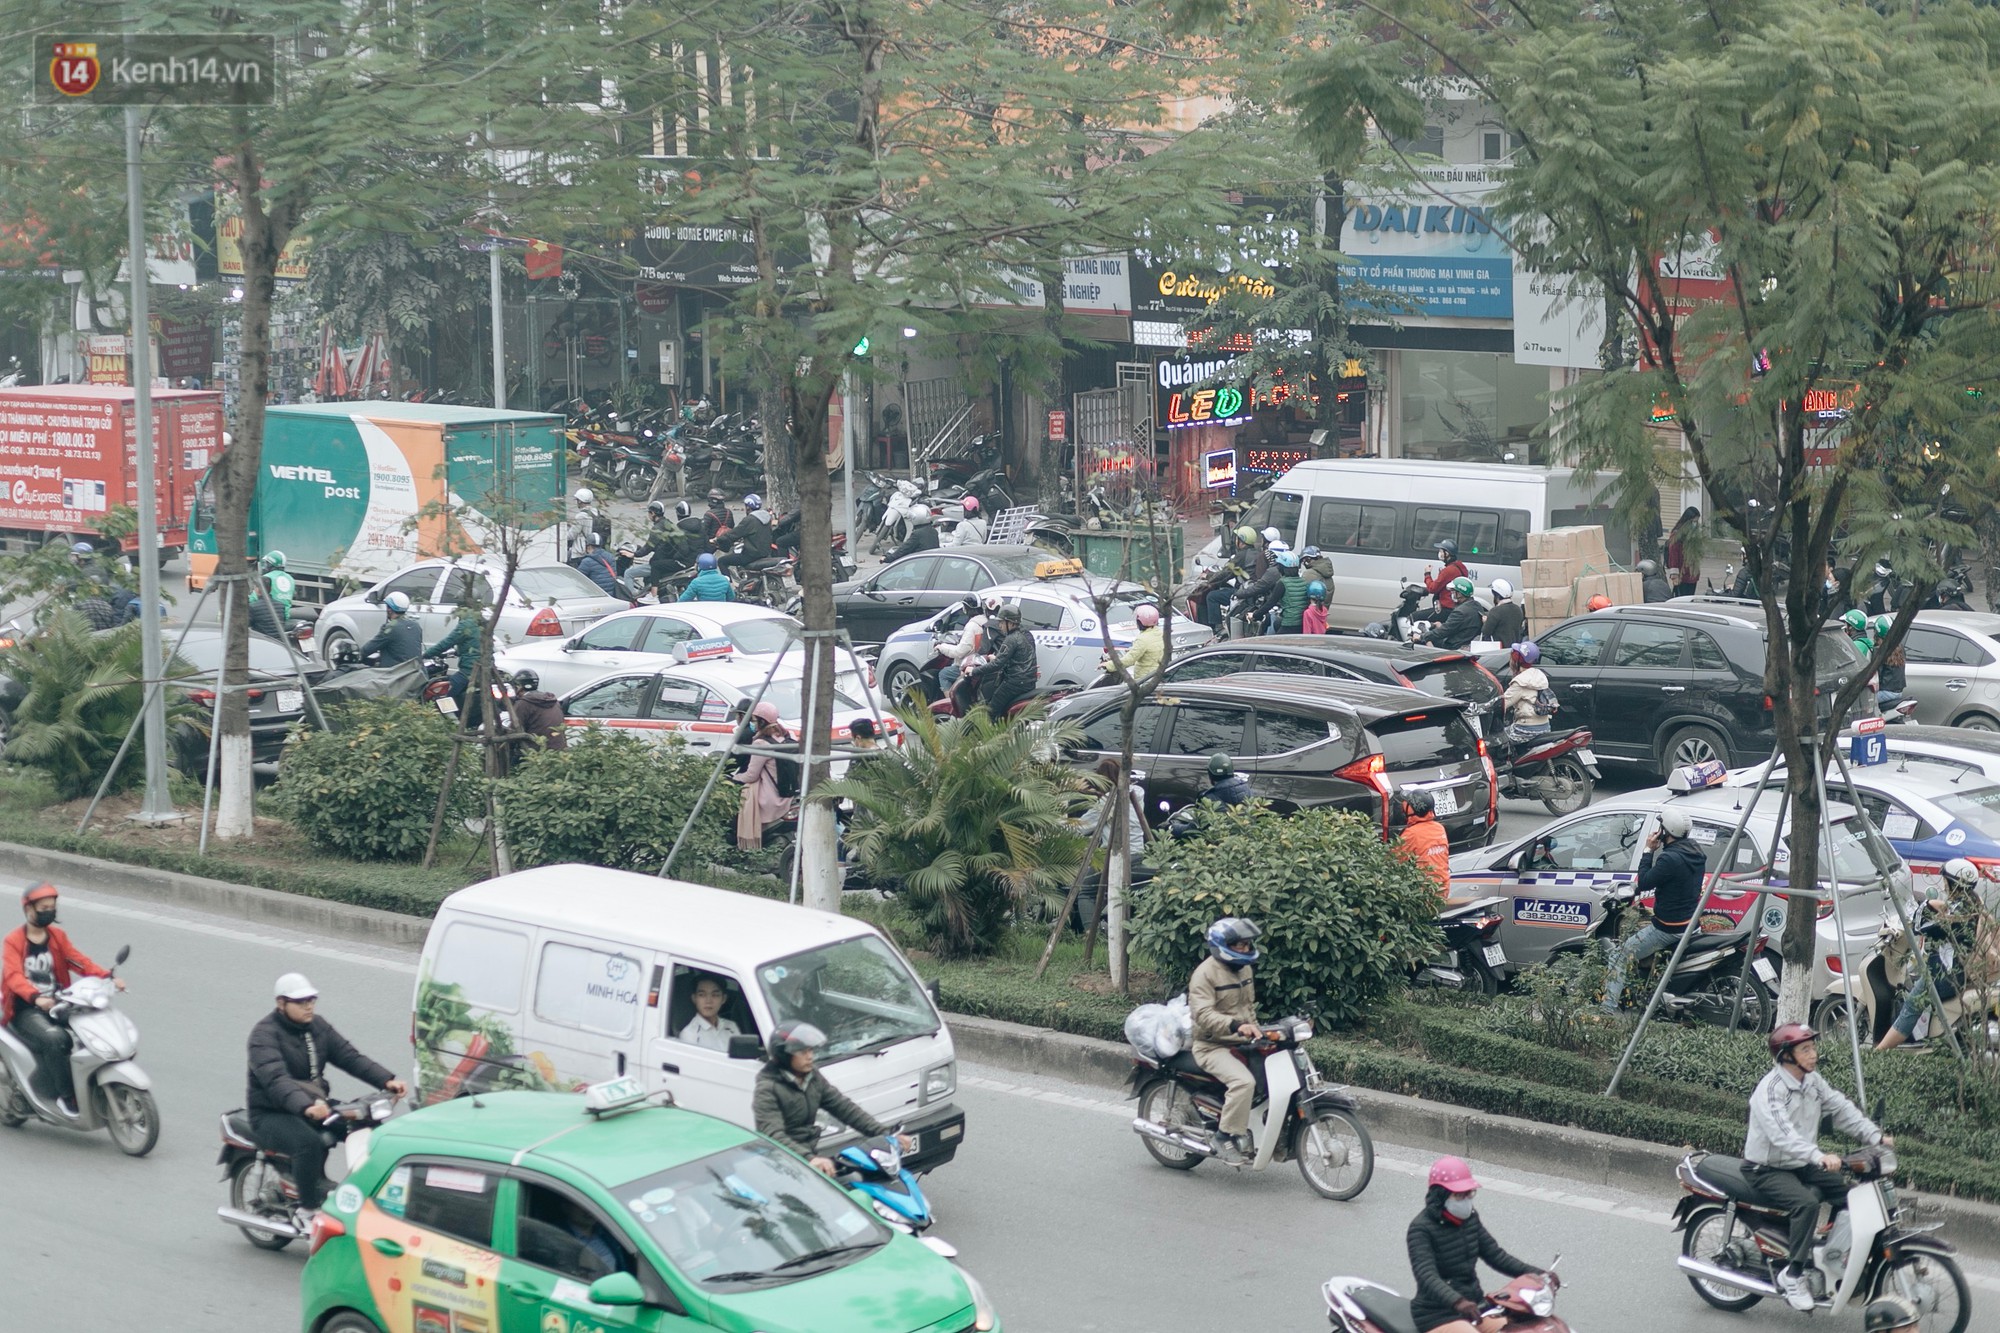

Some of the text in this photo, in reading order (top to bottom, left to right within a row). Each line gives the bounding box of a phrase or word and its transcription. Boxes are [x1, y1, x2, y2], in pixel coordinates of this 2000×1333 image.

[1353, 204, 1496, 235] DAIKIN
[677, 227, 702, 240] HOME
[1100, 260, 1122, 276] INOX
[1358, 267, 1368, 277] TY
[1382, 264, 1404, 278] PHẦN
[1406, 267, 1436, 279] THƯƠNG
[1439, 269, 1454, 281] MẠI
[1456, 269, 1474, 280] VINH
[1476, 270, 1490, 280] GIA
[1069, 282, 1101, 303] NGHIỆP
[1663, 296, 1696, 307] TRUNG
[1531, 343, 1539, 351] 77
[1168, 387, 1243, 423] LED
[9, 428, 31, 443] MIỄN
[32, 430, 47, 444] PHÍ
[373, 472, 411, 484] 1900.8095
[324, 486, 361, 499] post
[1081, 620, 1095, 630] 993
[690, 640, 731, 652] TAXIGROUP
[1867, 737, 1881, 762] G7
[1549, 903, 1581, 914] TAXI
[1525, 912, 1580, 923] 38.230.230
[585, 982, 614, 1000] MINH
